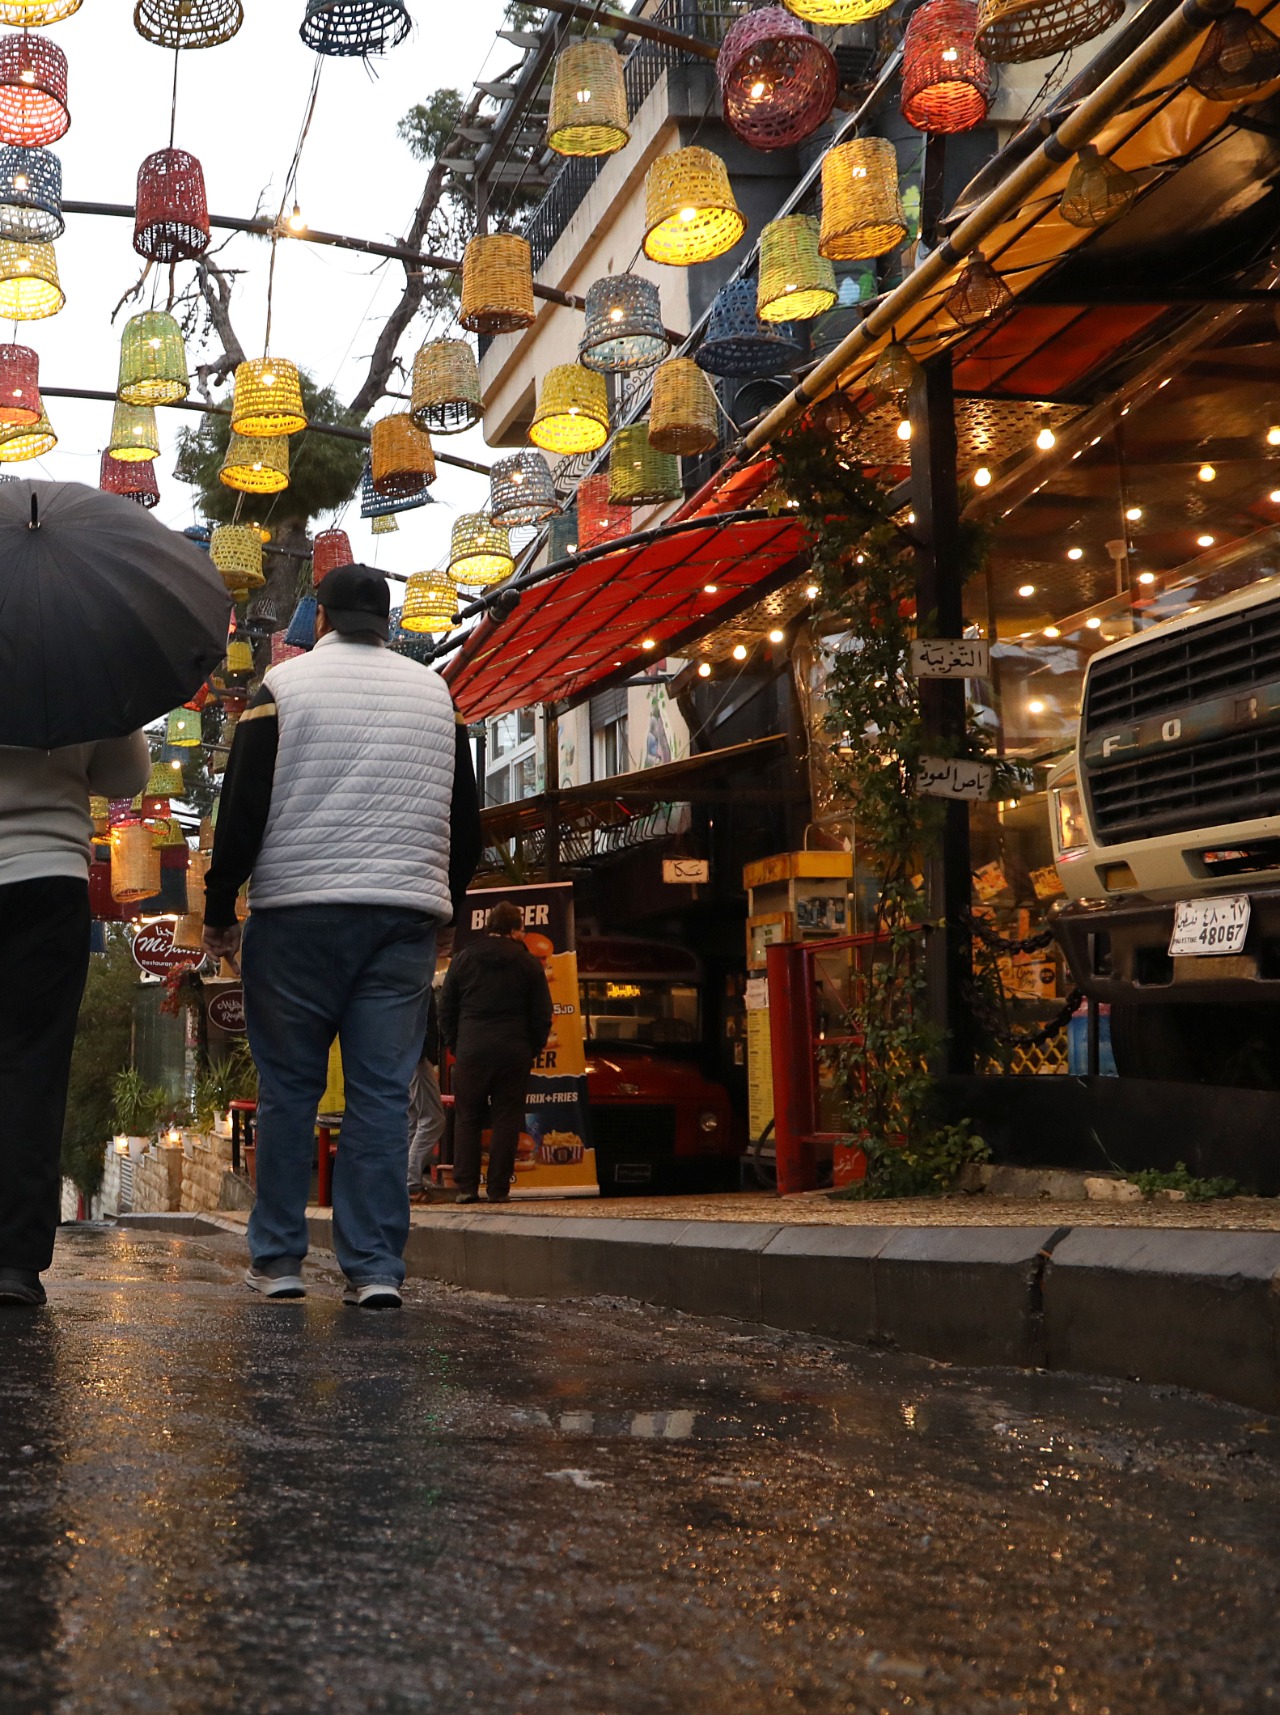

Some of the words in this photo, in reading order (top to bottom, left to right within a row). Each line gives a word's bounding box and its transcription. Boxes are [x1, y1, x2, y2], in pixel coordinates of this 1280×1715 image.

[1199, 923, 1244, 946] 48067
[141, 959, 173, 968] Restauran
[553, 1004, 574, 1014] 5JD
[525, 1092, 578, 1104] TRIX+FRIES
